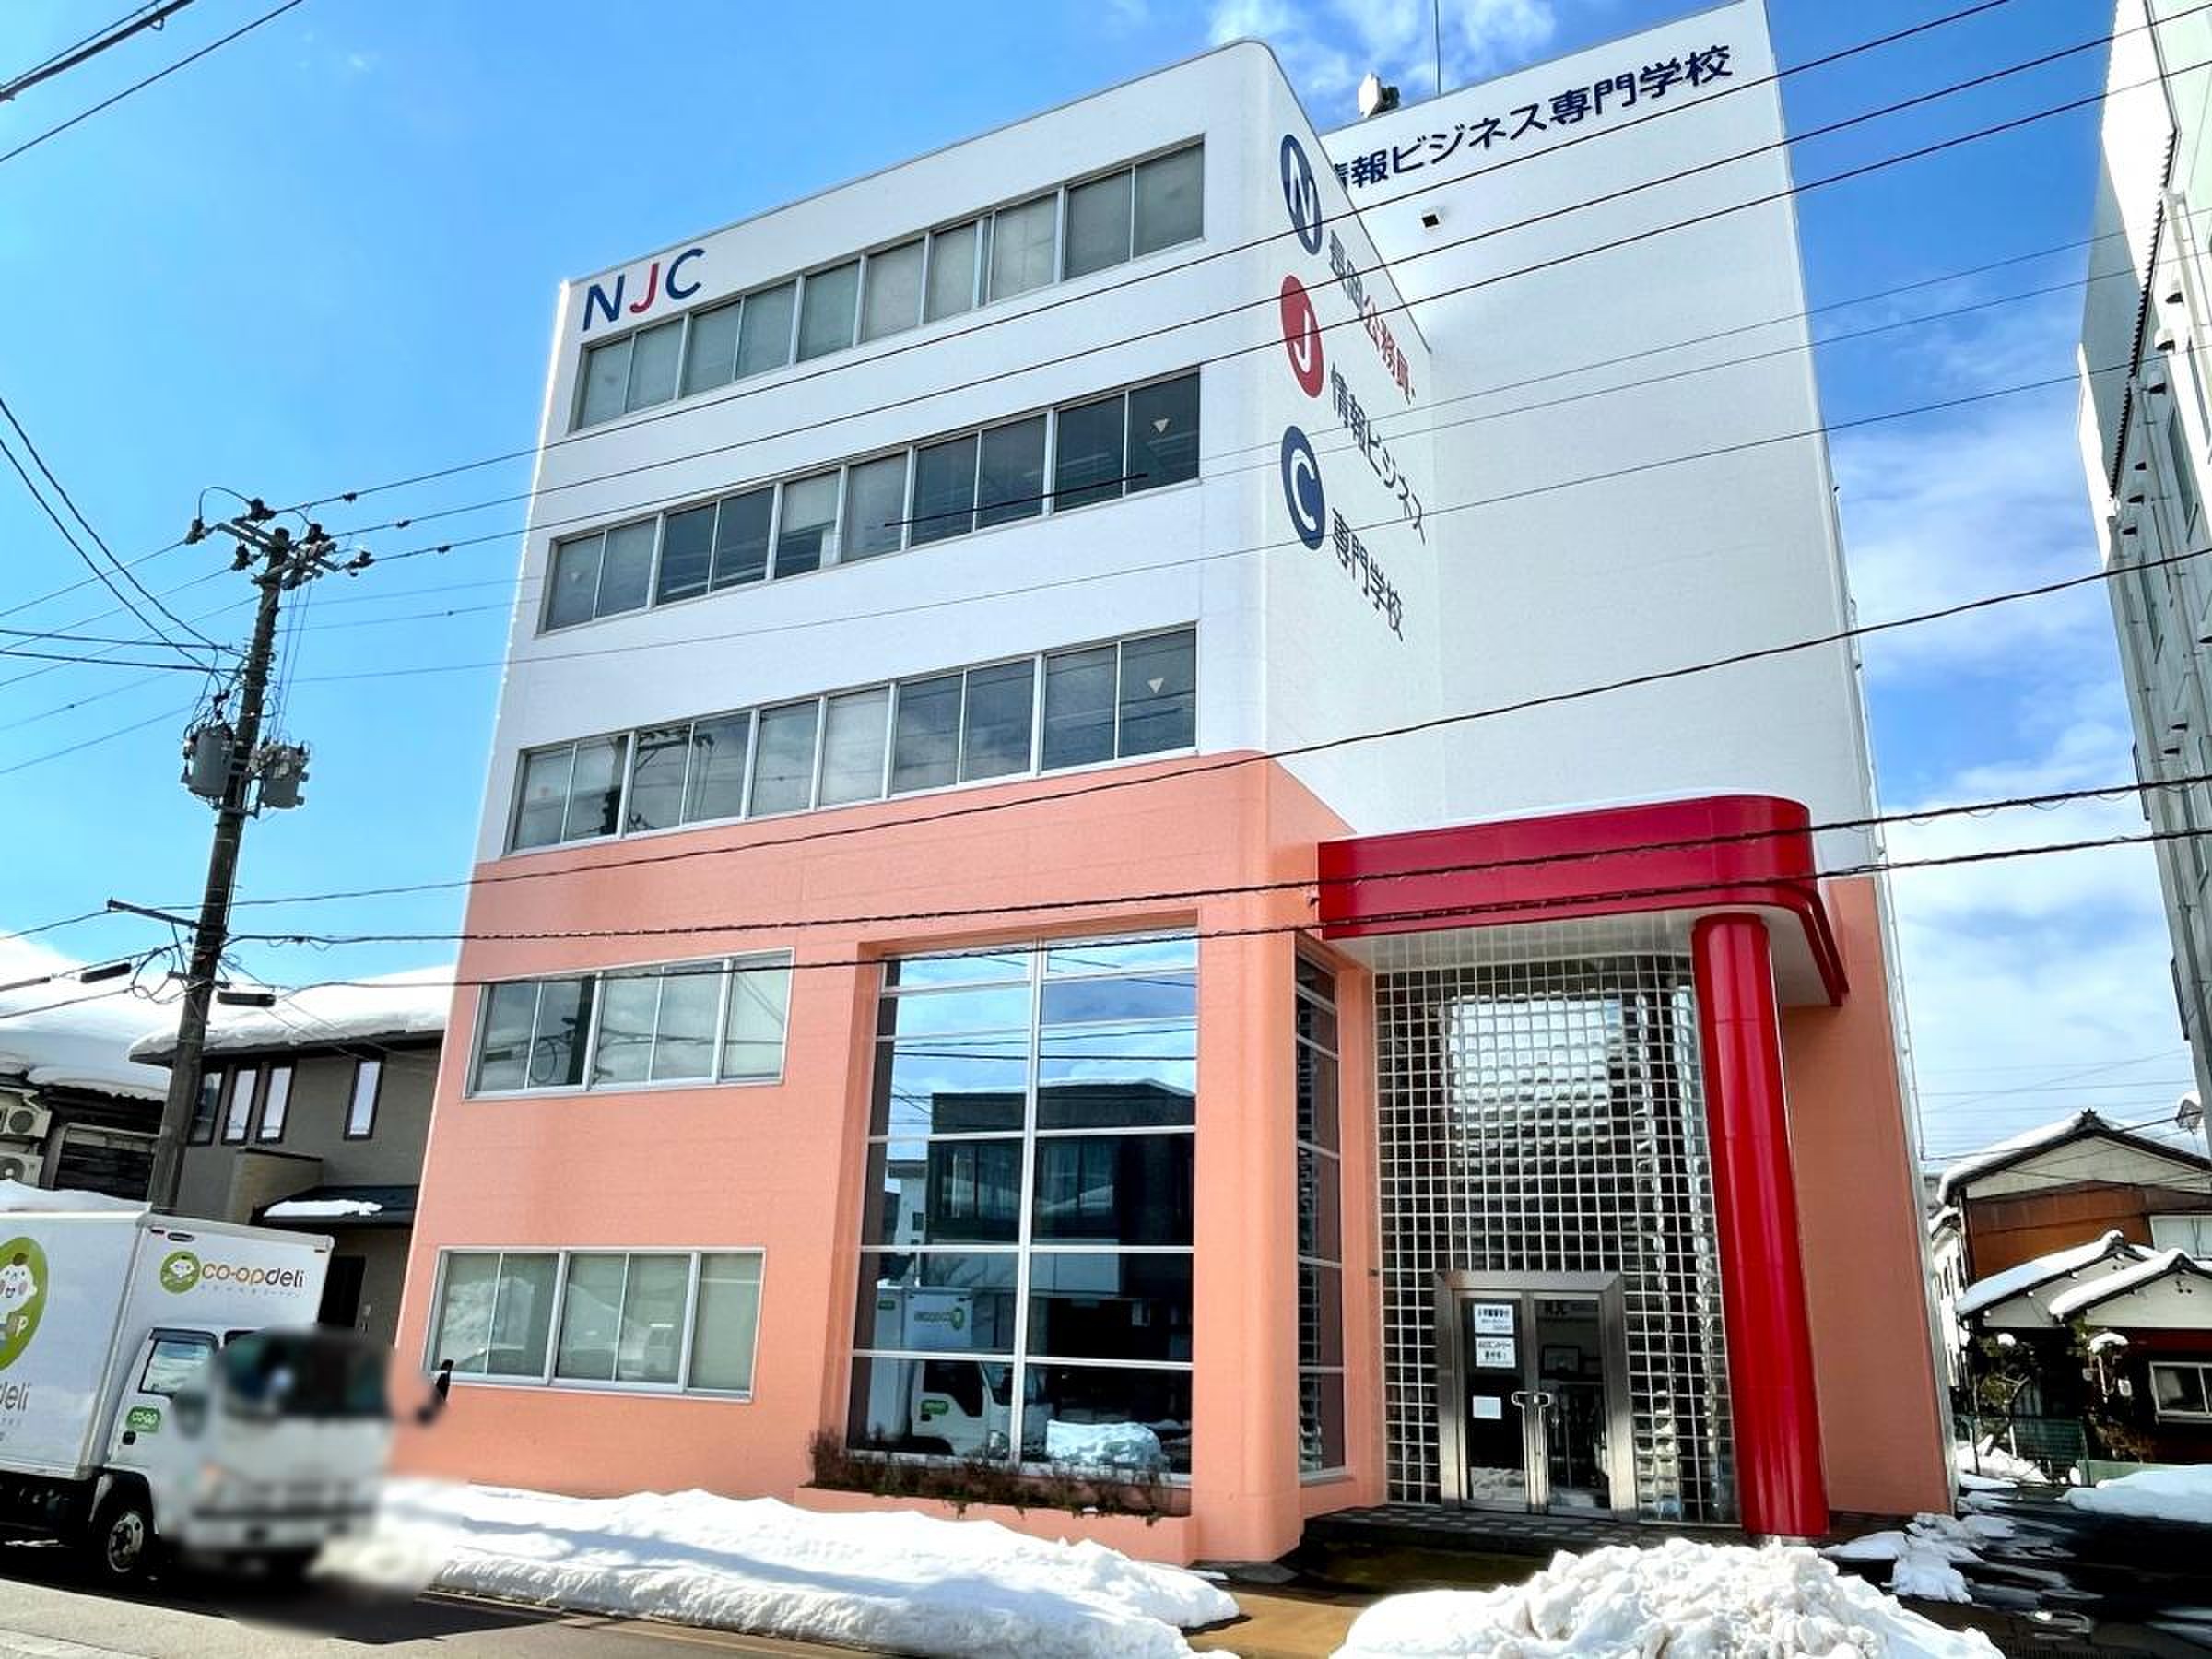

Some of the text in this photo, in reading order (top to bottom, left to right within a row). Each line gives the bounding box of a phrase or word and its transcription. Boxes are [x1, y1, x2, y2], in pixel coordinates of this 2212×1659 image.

[582, 248, 705, 331] NJC
[1332, 507, 1403, 641] 専門学校
